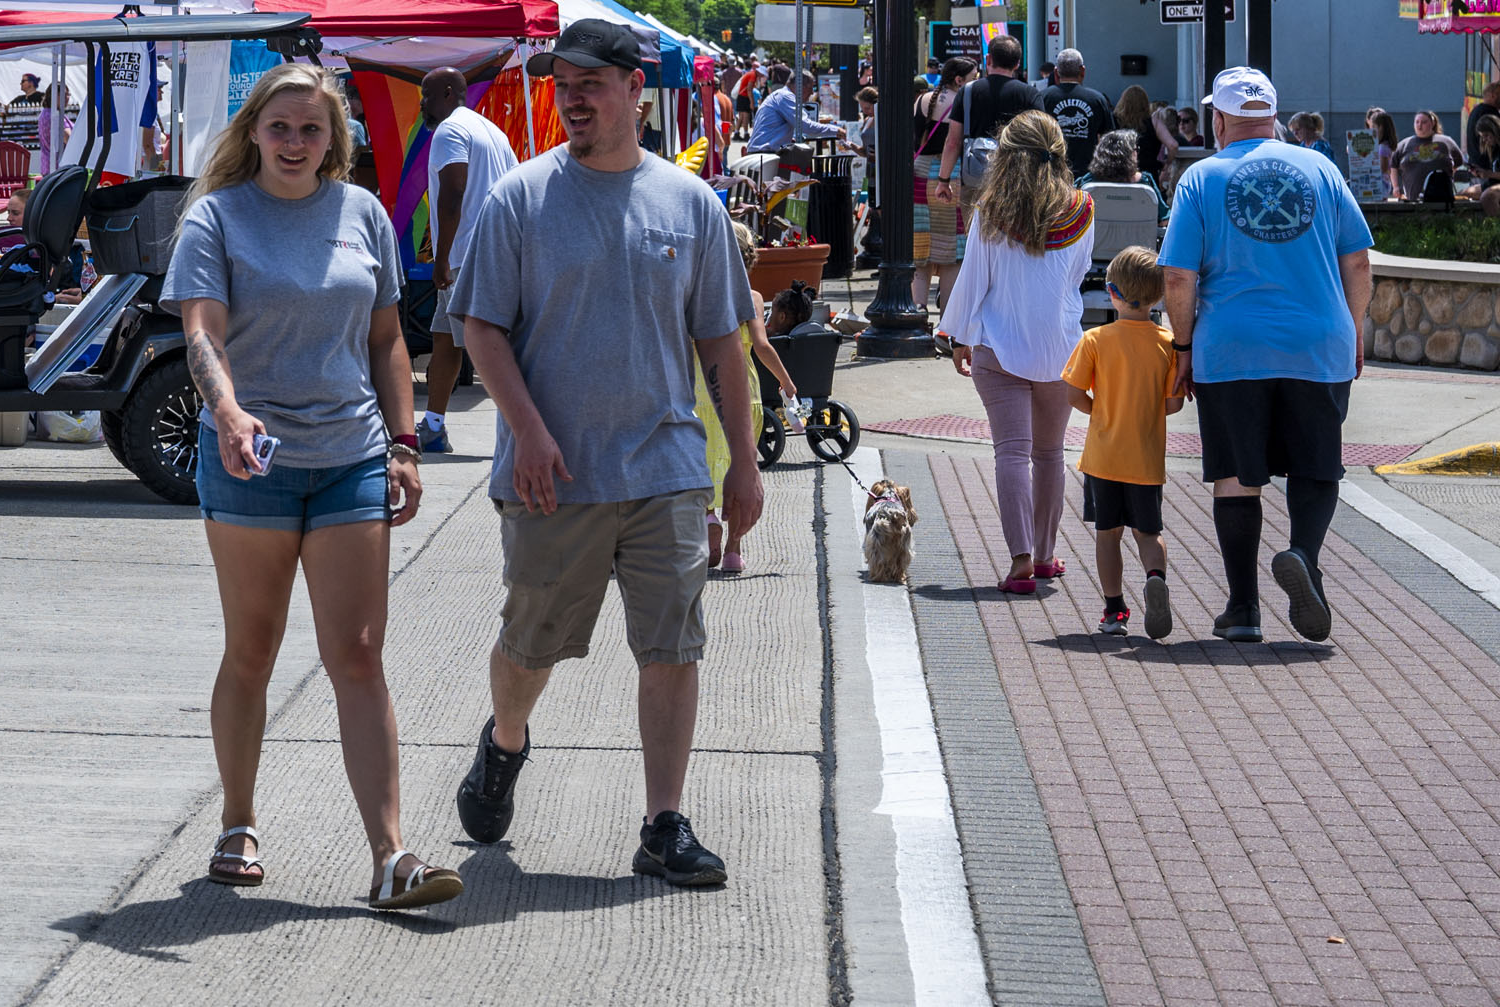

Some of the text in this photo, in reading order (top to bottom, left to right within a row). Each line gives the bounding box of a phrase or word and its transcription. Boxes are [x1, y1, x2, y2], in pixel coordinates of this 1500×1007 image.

[1168, 6, 1188, 17] ONE
[1245, 86, 1265, 97] BYC
[1053, 98, 1094, 118] REFLECTIONS
[1227, 161, 1313, 219] SALTY WAVES & CLEAR SKIES
[1253, 227, 1298, 240] CHARTERS
